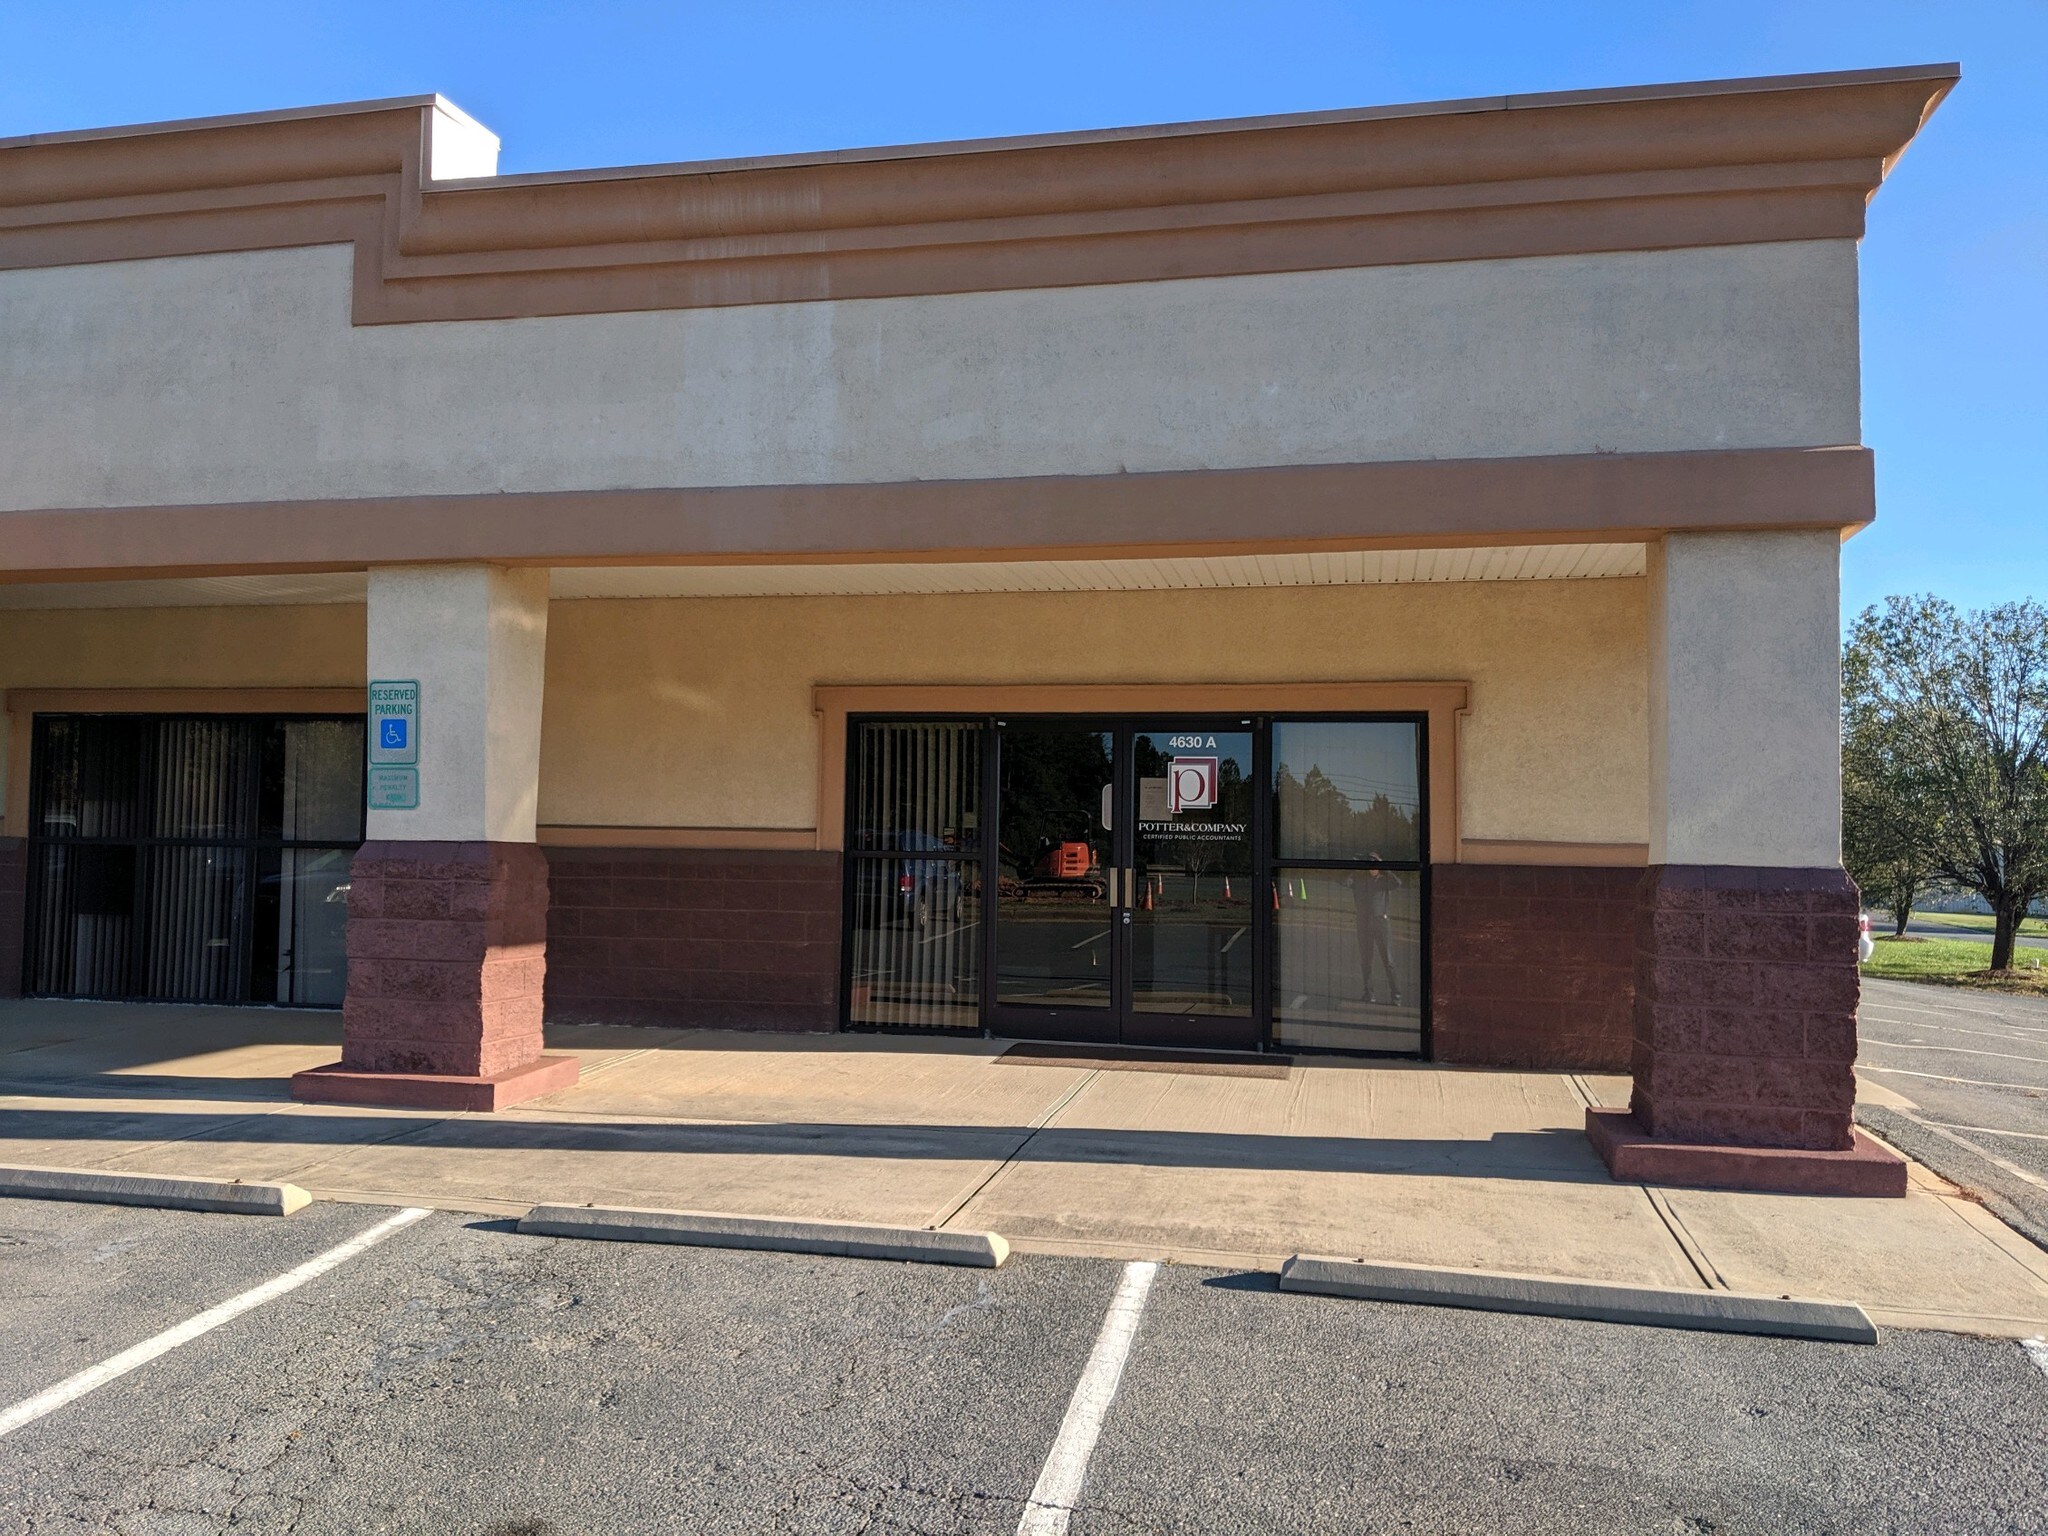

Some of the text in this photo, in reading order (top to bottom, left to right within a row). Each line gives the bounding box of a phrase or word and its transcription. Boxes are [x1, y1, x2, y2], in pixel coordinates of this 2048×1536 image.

[371, 689, 416, 701] RESERVED
[375, 704, 413, 715] PARKING
[1169, 736, 1217, 748] 4630 A
[1138, 822, 1247, 833] POTTER&COMPANY
